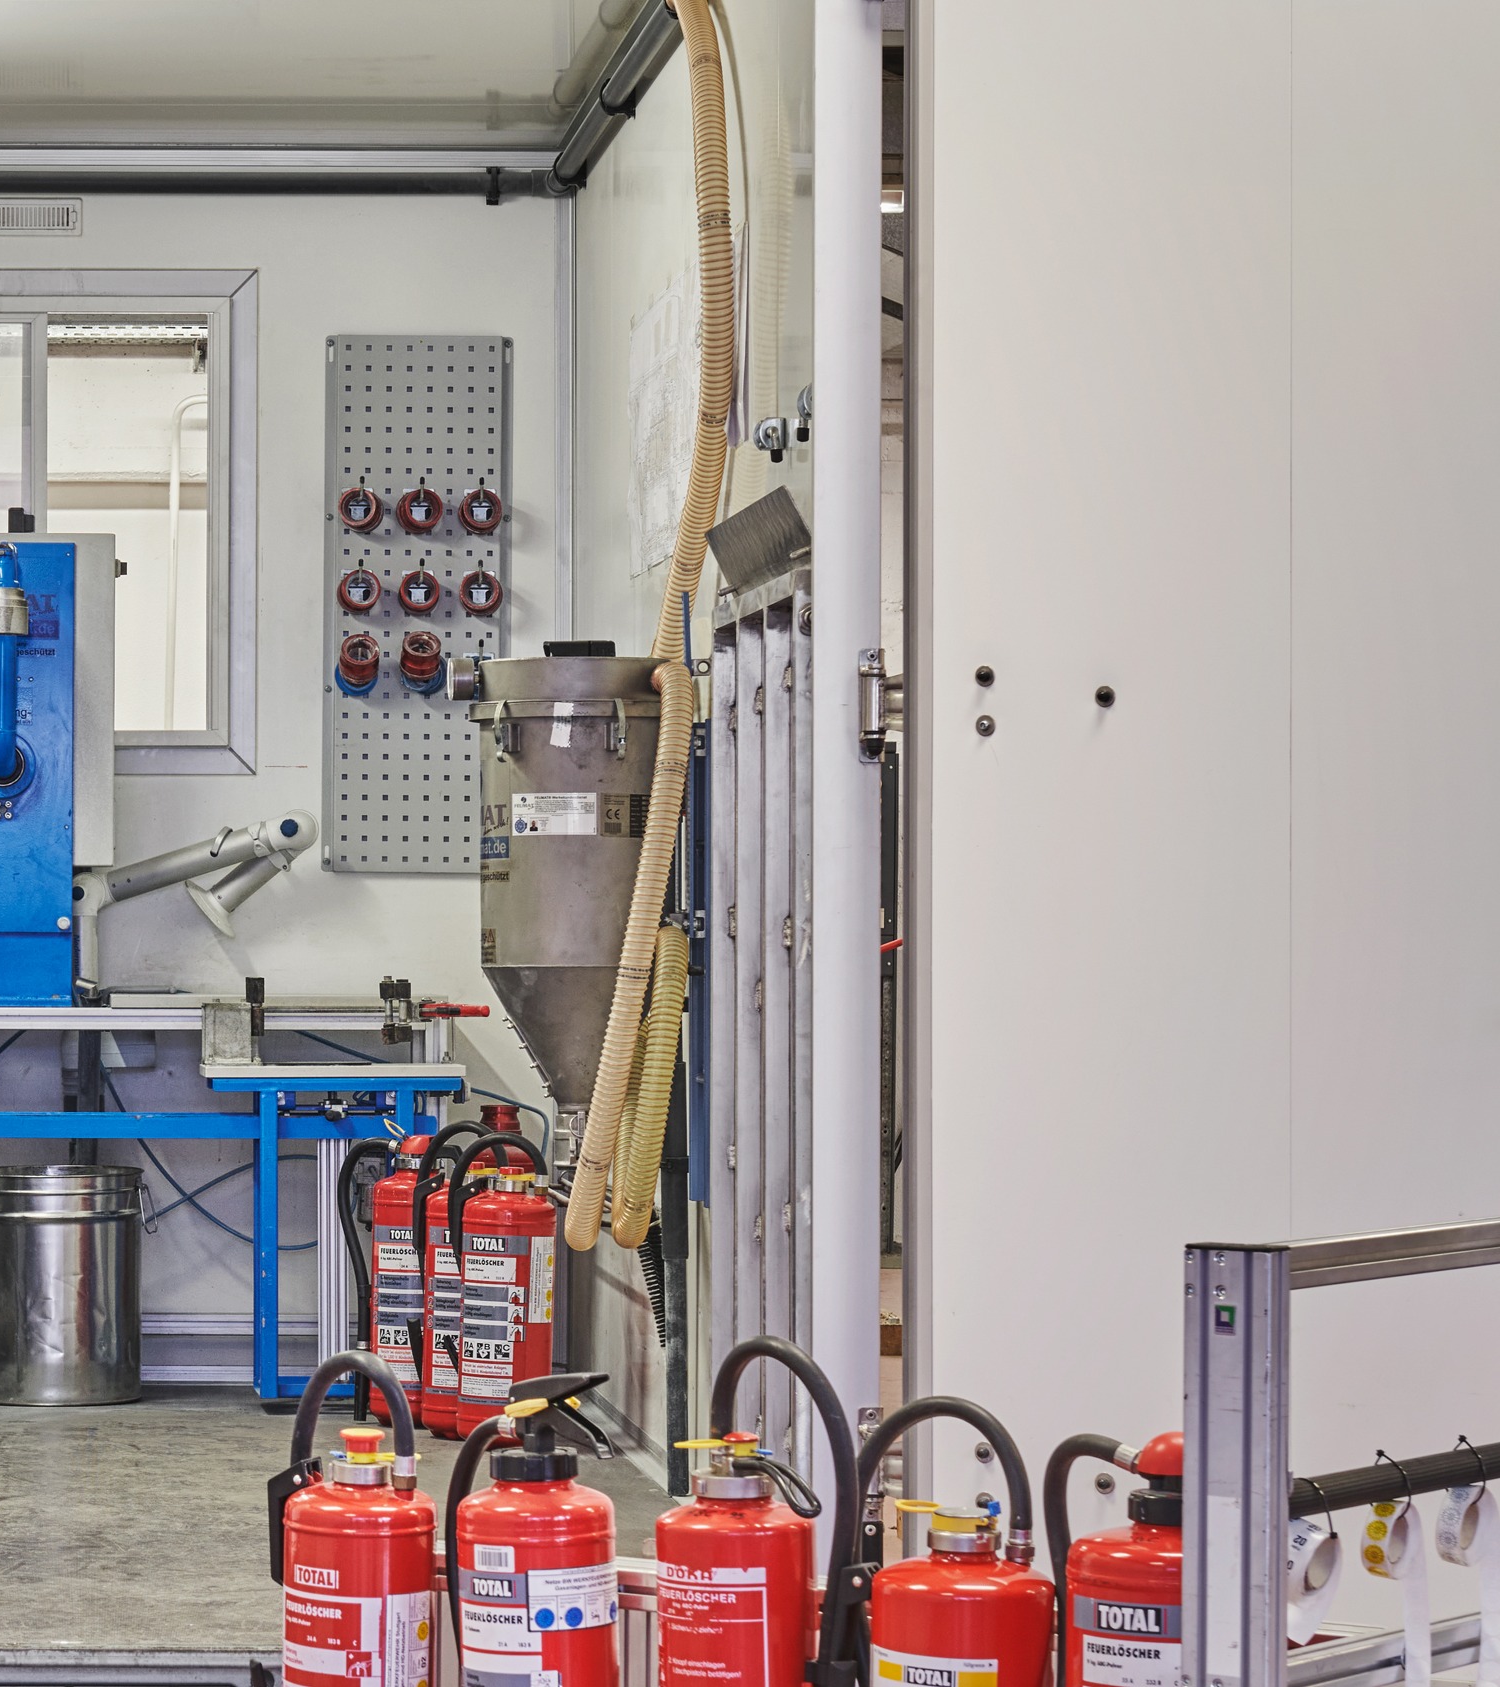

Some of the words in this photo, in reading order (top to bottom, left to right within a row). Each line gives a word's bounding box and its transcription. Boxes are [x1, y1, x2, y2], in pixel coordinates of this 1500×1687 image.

[381, 1247, 418, 1255] FEUERLÖSCH
[472, 1237, 504, 1251] TOTAL
[467, 1258, 504, 1266] FEUERLÖSCHER
[298, 1567, 333, 1586] TOTAL
[473, 1578, 511, 1597] TOTAL
[659, 1586, 736, 1604] FEUERLÖSCHER
[286, 1599, 342, 1619] FEUERLÖSCHER
[464, 1610, 523, 1624] FEUERLÖSCHER
[1098, 1605, 1160, 1632] TOTAL
[1087, 1642, 1160, 1659] FEUERLÖSCHER
[907, 1667, 951, 1687] TOTAL
